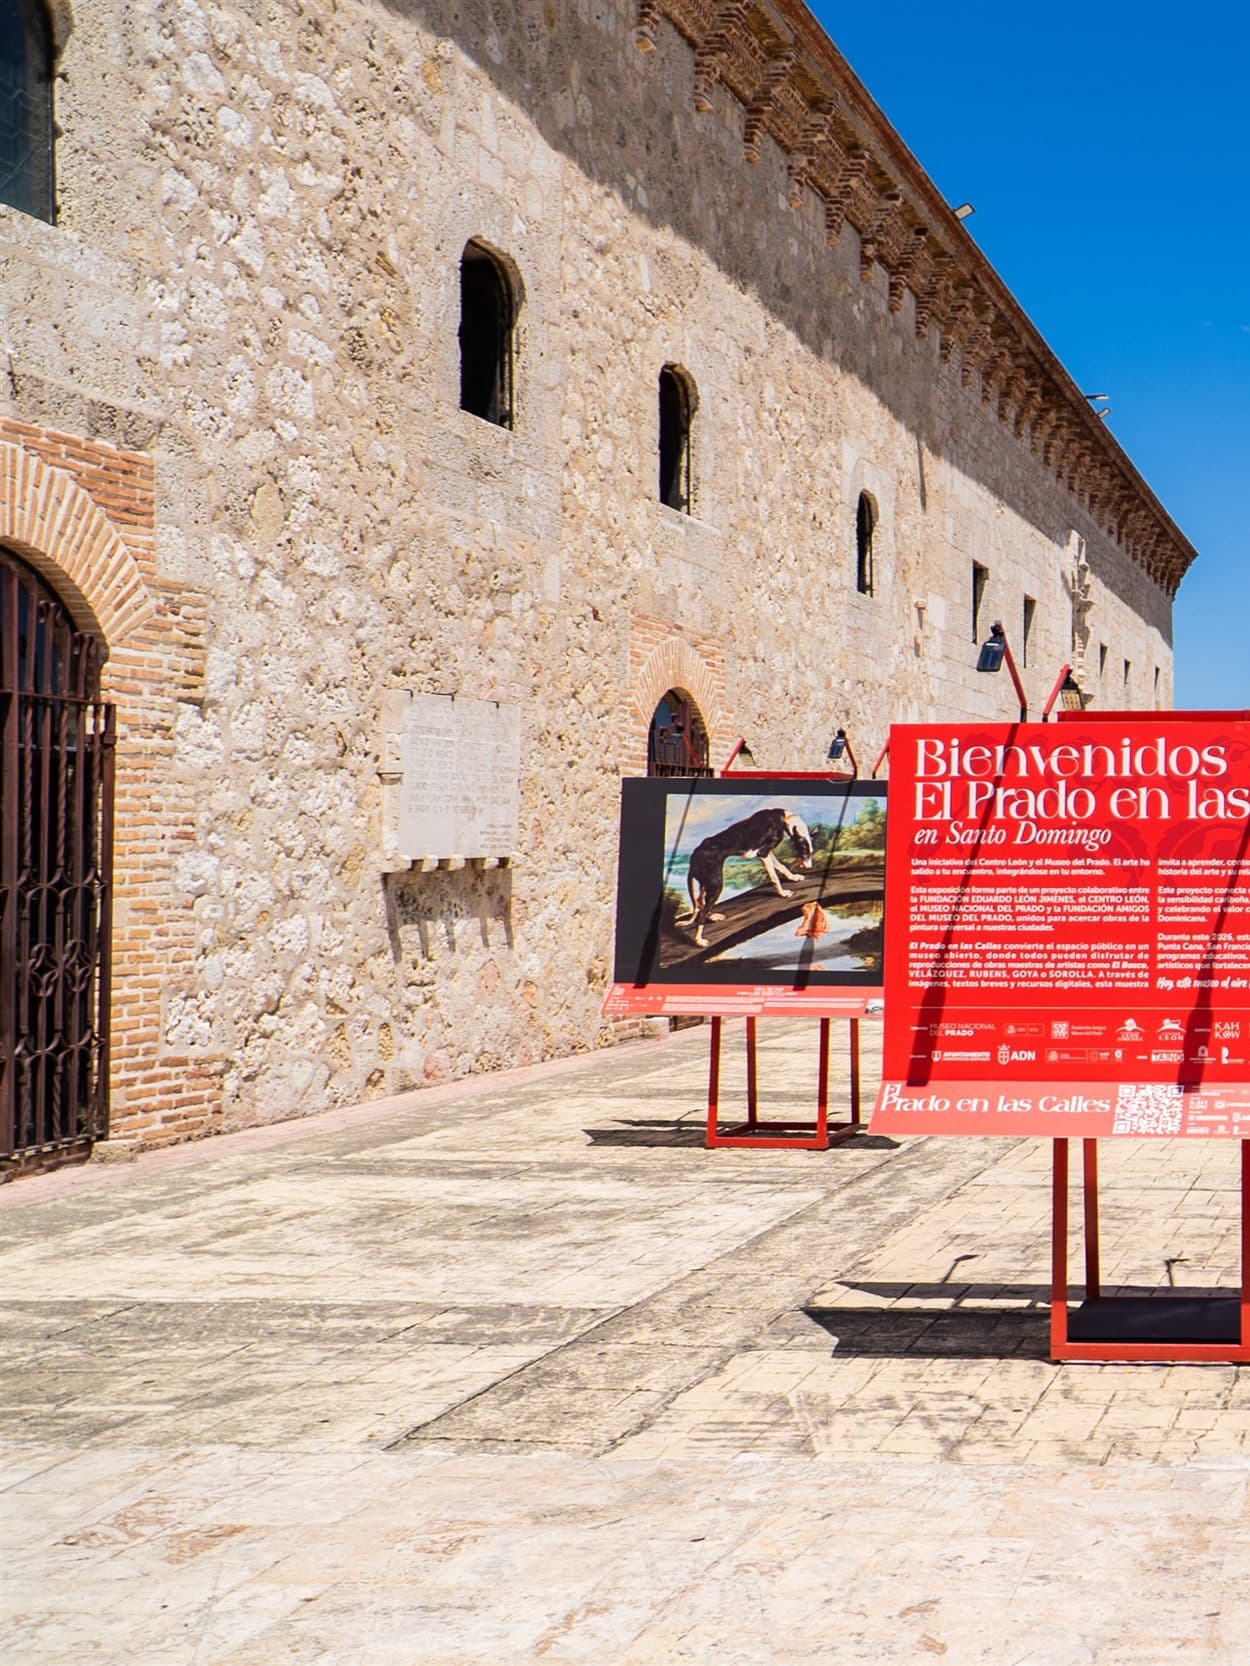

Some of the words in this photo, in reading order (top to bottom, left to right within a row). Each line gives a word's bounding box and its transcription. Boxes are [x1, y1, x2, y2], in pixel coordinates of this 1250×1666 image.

[914, 736, 1228, 778] Bienvenidos
[913, 780, 953, 820] El
[966, 779, 1096, 819] Prado
[1109, 787, 1171, 820] en
[1187, 780, 1250, 820] las
[914, 829, 938, 845] en
[945, 820, 1006, 845] Santo
[1012, 820, 1112, 852] Domingo
[945, 1029, 974, 1037] PRADO
[1010, 1049, 1037, 1061] ADN
[956, 1098, 989, 1112] en
[997, 1095, 1032, 1112] las
[1039, 1095, 1111, 1113] Calles
